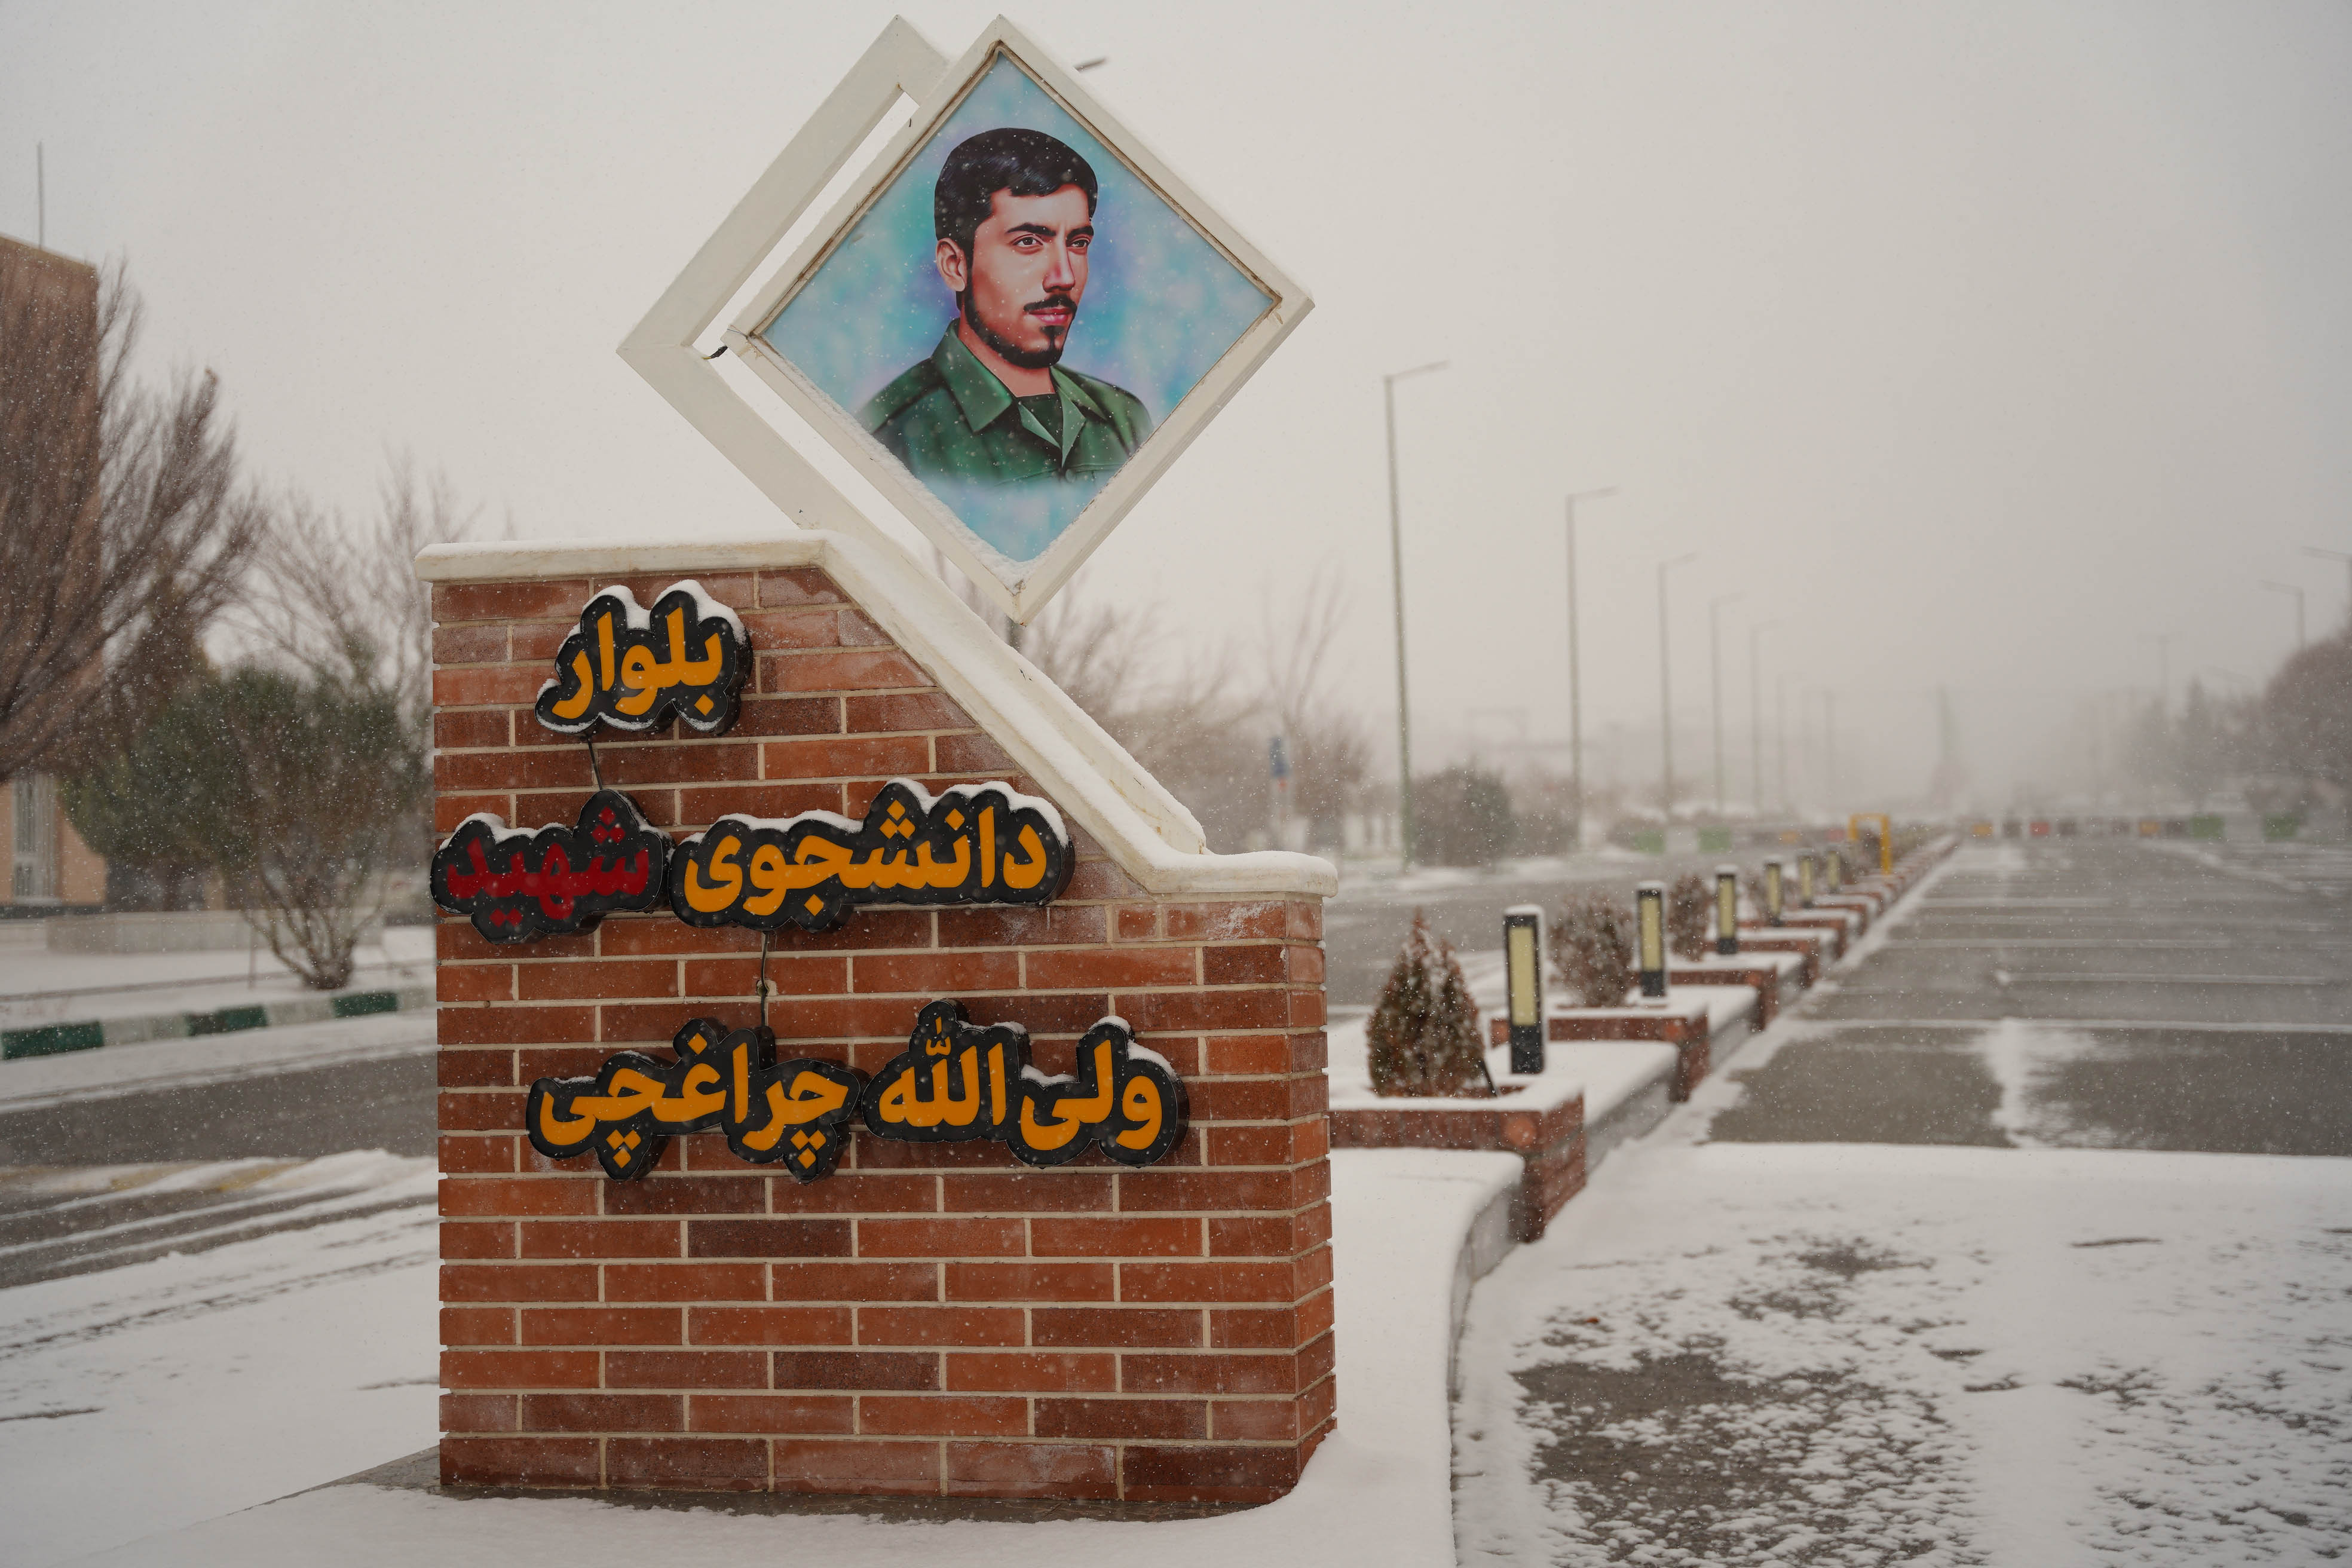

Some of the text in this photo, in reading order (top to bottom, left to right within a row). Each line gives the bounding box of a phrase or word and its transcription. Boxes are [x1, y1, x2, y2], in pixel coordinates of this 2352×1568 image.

[552, 607, 723, 719] بلوار
[447, 800, 1048, 927] دانشجوی شهید
[539, 1033, 849, 1169] چراغچی
[1019, 1039, 1163, 1151] ولی
